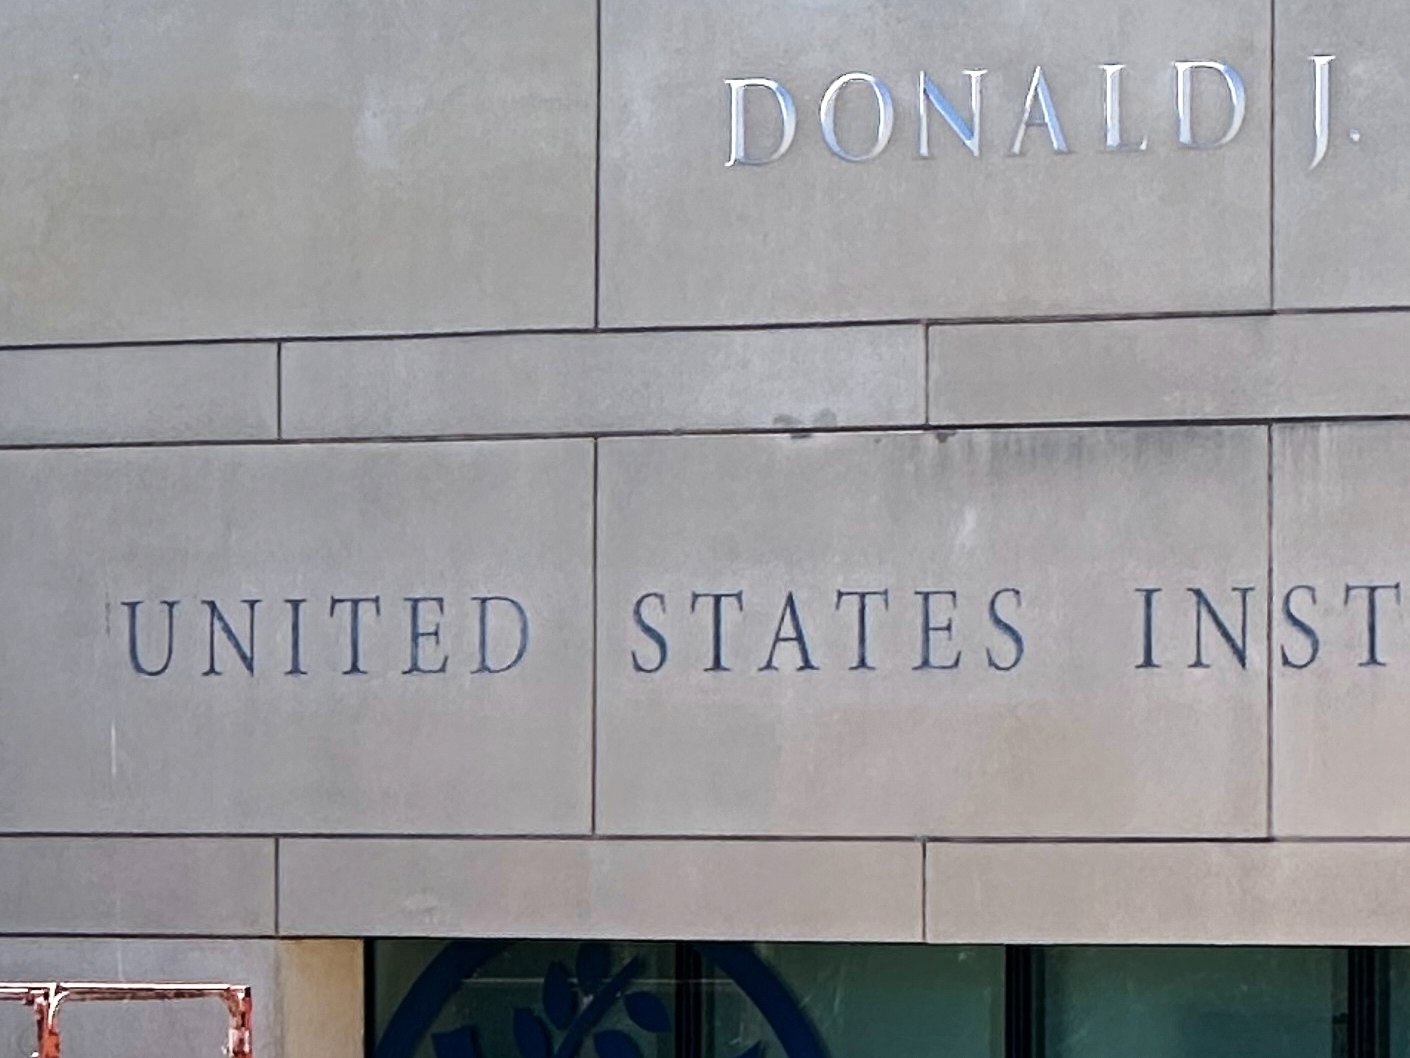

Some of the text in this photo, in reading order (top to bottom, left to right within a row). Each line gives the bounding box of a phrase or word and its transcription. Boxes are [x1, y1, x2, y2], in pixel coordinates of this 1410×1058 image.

[723, 60, 1247, 167] DONALD
[1308, 54, 1361, 171] J.
[120, 595, 530, 677] UNITED
[630, 587, 1026, 674] STATES
